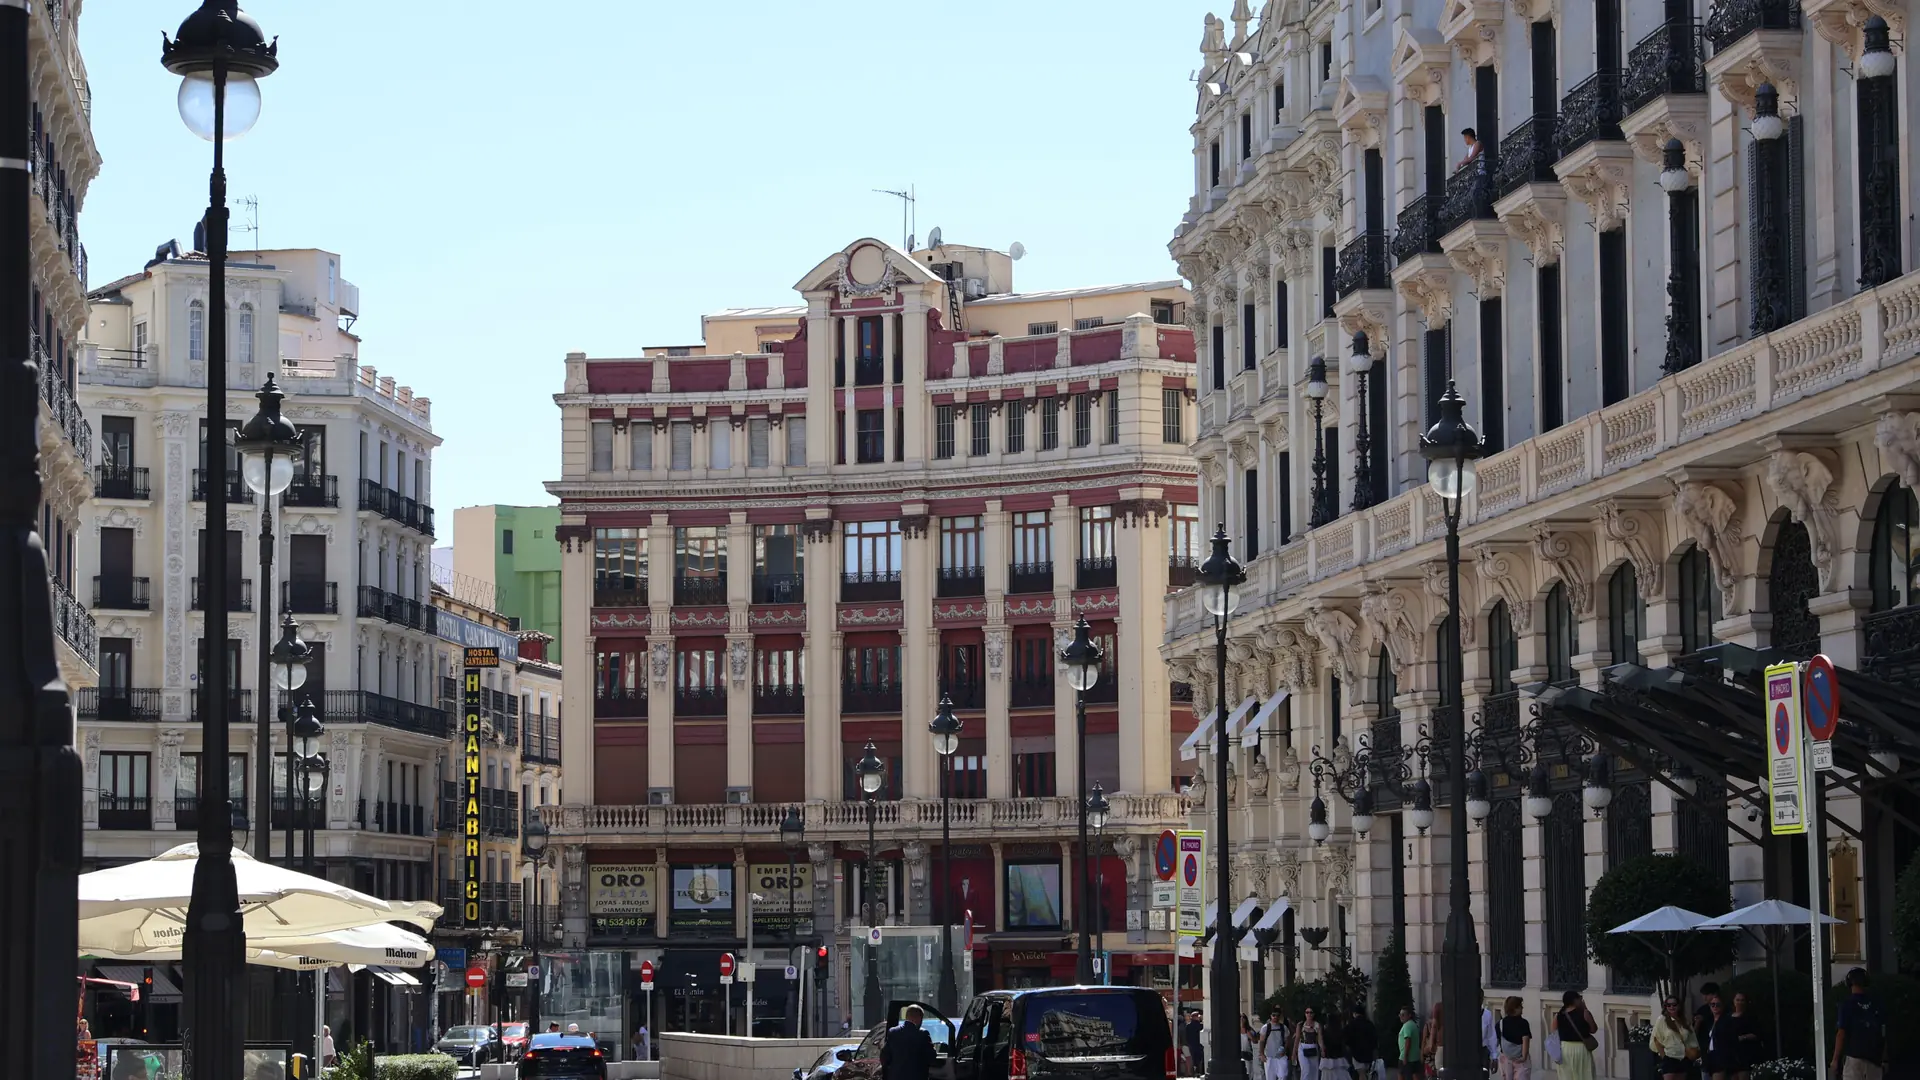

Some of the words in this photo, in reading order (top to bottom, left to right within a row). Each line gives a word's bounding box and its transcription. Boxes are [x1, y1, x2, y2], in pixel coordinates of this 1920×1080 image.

[465, 657, 498, 666] CANTABRICO
[466, 674, 479, 692] H
[465, 714, 479, 921] CANTABRICO
[601, 874, 646, 887] ORO
[760, 876, 804, 889] ORO
[598, 889, 649, 898] PLATA
[596, 918, 606, 927] 91
[608, 918, 624, 927] 532
[385, 947, 418, 959] Mahou
